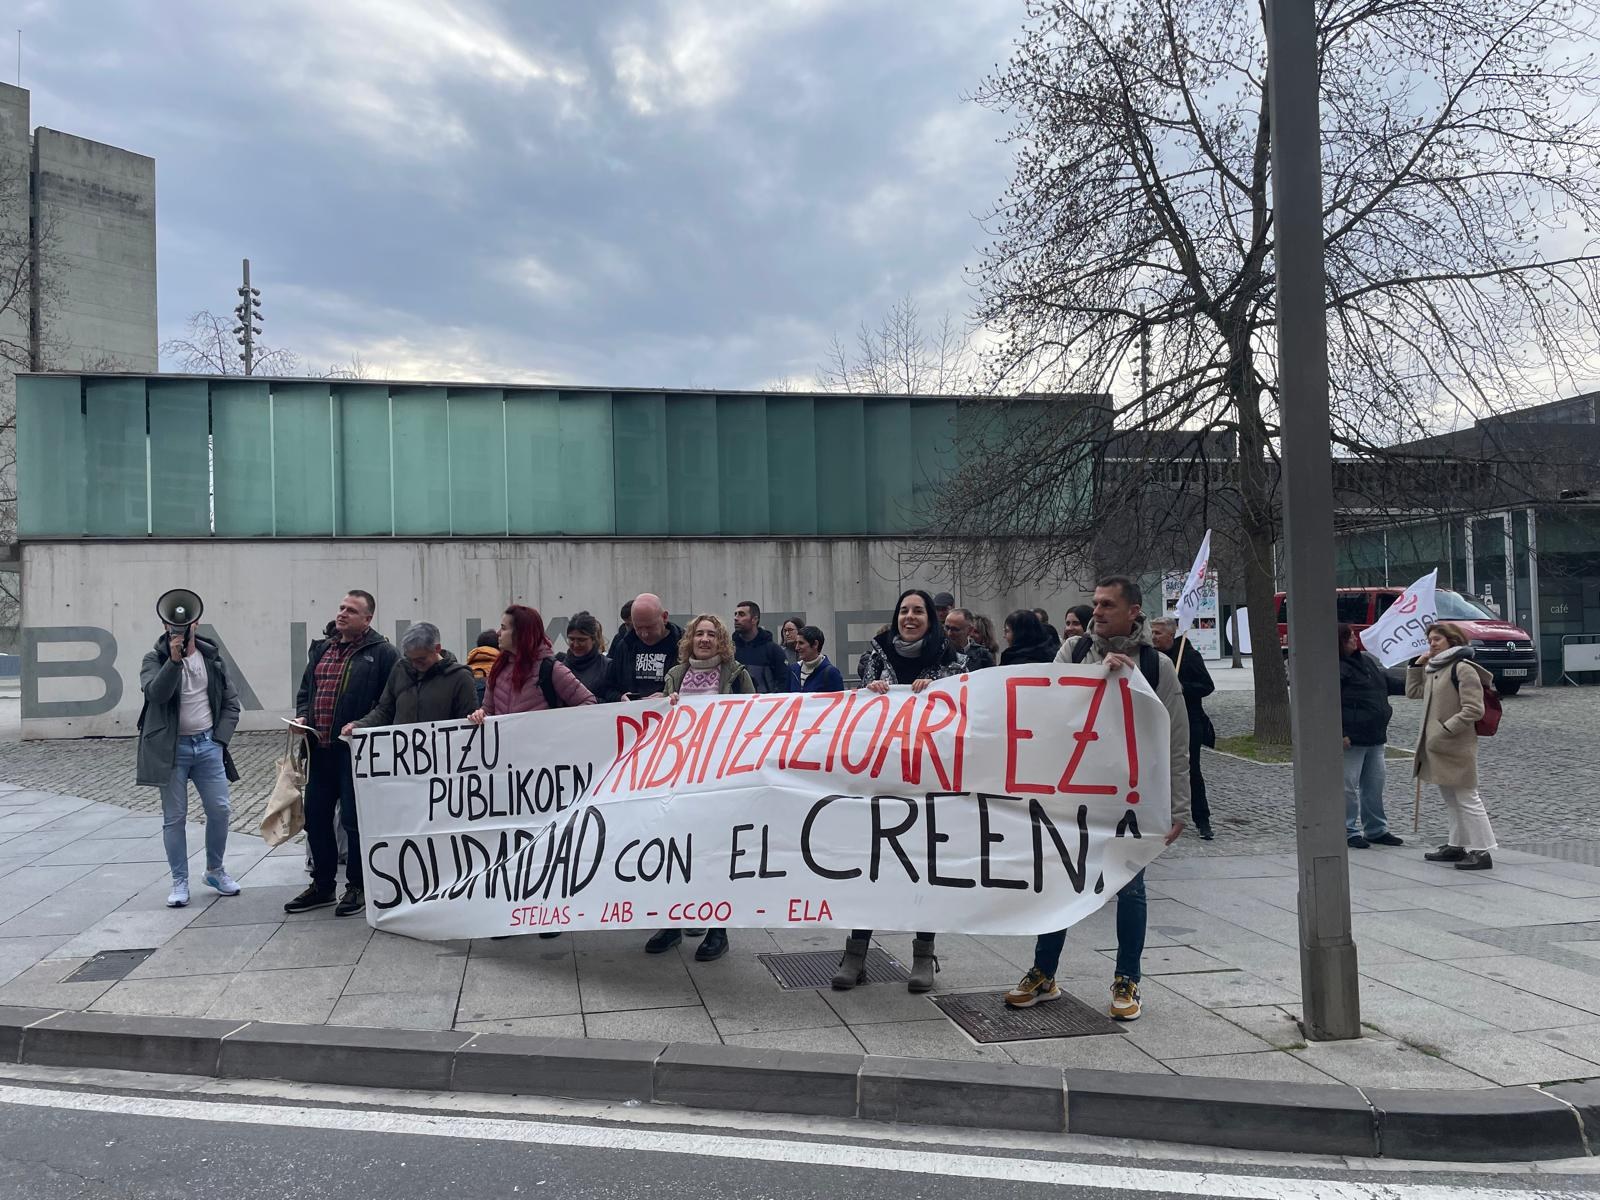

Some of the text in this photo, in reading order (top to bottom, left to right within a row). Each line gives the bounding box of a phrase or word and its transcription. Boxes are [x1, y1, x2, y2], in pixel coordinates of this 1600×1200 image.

[1550, 602, 1569, 614] café
[429, 762, 593, 821] PUBLIKOEN
[1005, 677, 1140, 804] EZ!
[615, 833, 692, 884] CON
[730, 824, 787, 881] EL
[510, 902, 570, 926] STEILAS
[600, 901, 633, 923] LAB
[668, 901, 732, 922] CCOO
[788, 899, 833, 922] ELA
